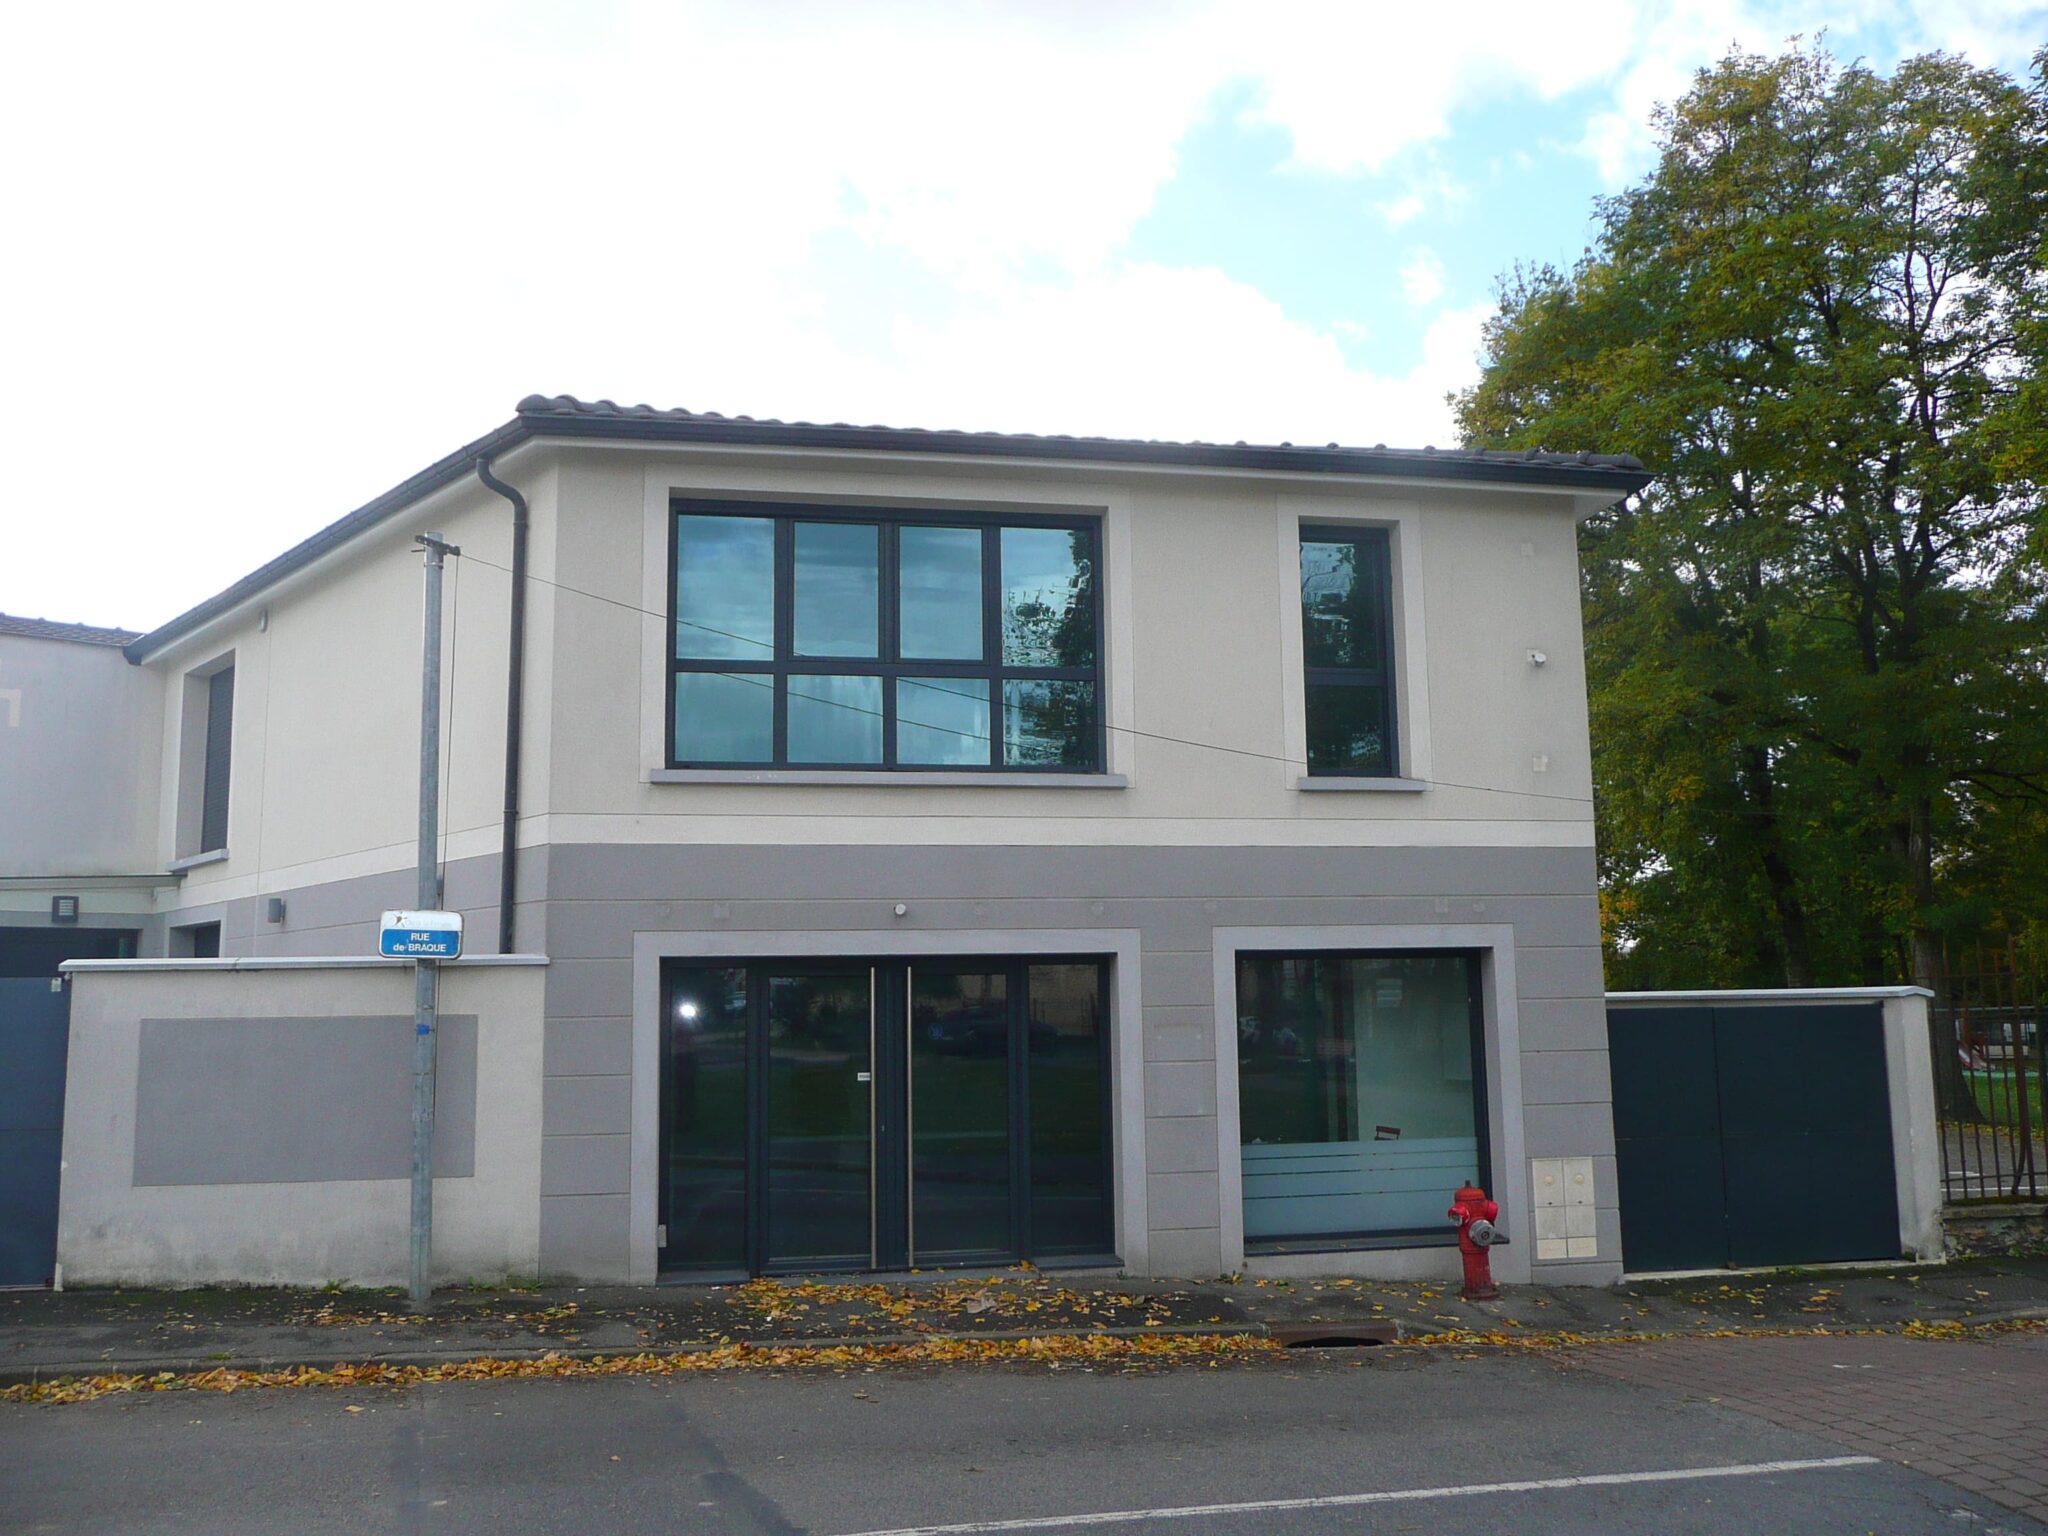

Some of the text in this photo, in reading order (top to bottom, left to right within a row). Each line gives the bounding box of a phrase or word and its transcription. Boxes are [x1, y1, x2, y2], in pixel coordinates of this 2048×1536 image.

[410, 932, 430, 941] RUE
[393, 943, 447, 952] de BRAQUE
